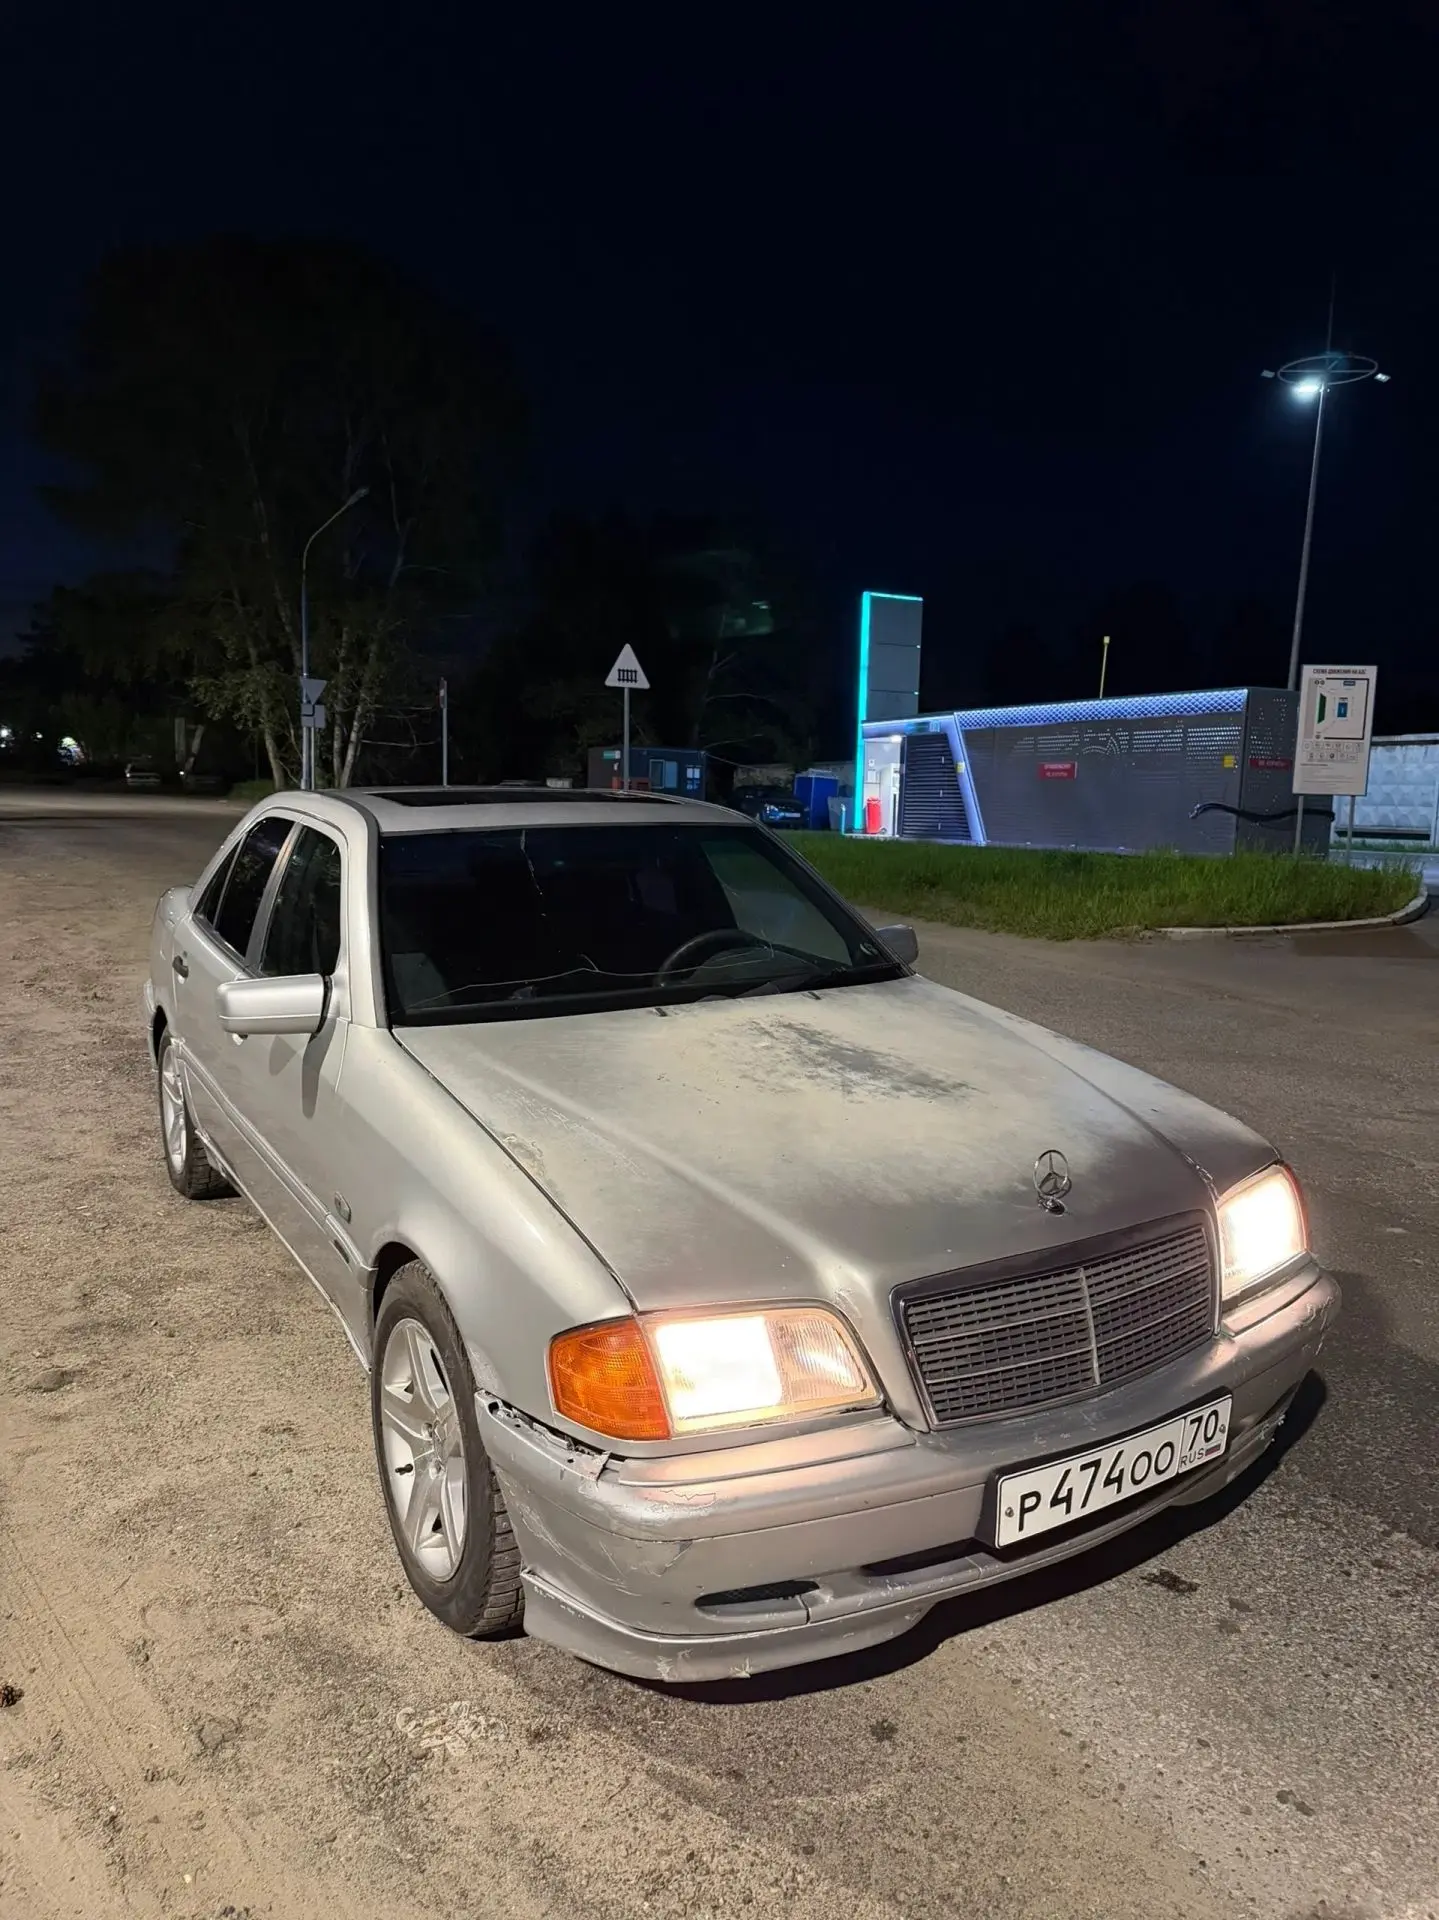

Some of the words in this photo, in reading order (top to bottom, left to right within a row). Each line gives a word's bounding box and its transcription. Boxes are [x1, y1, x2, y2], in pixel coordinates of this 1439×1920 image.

[1189, 1409, 1219, 1452] 70
[1180, 1446, 1205, 1467] RUS
[1018, 1441, 1175, 1532] Р474ОО
